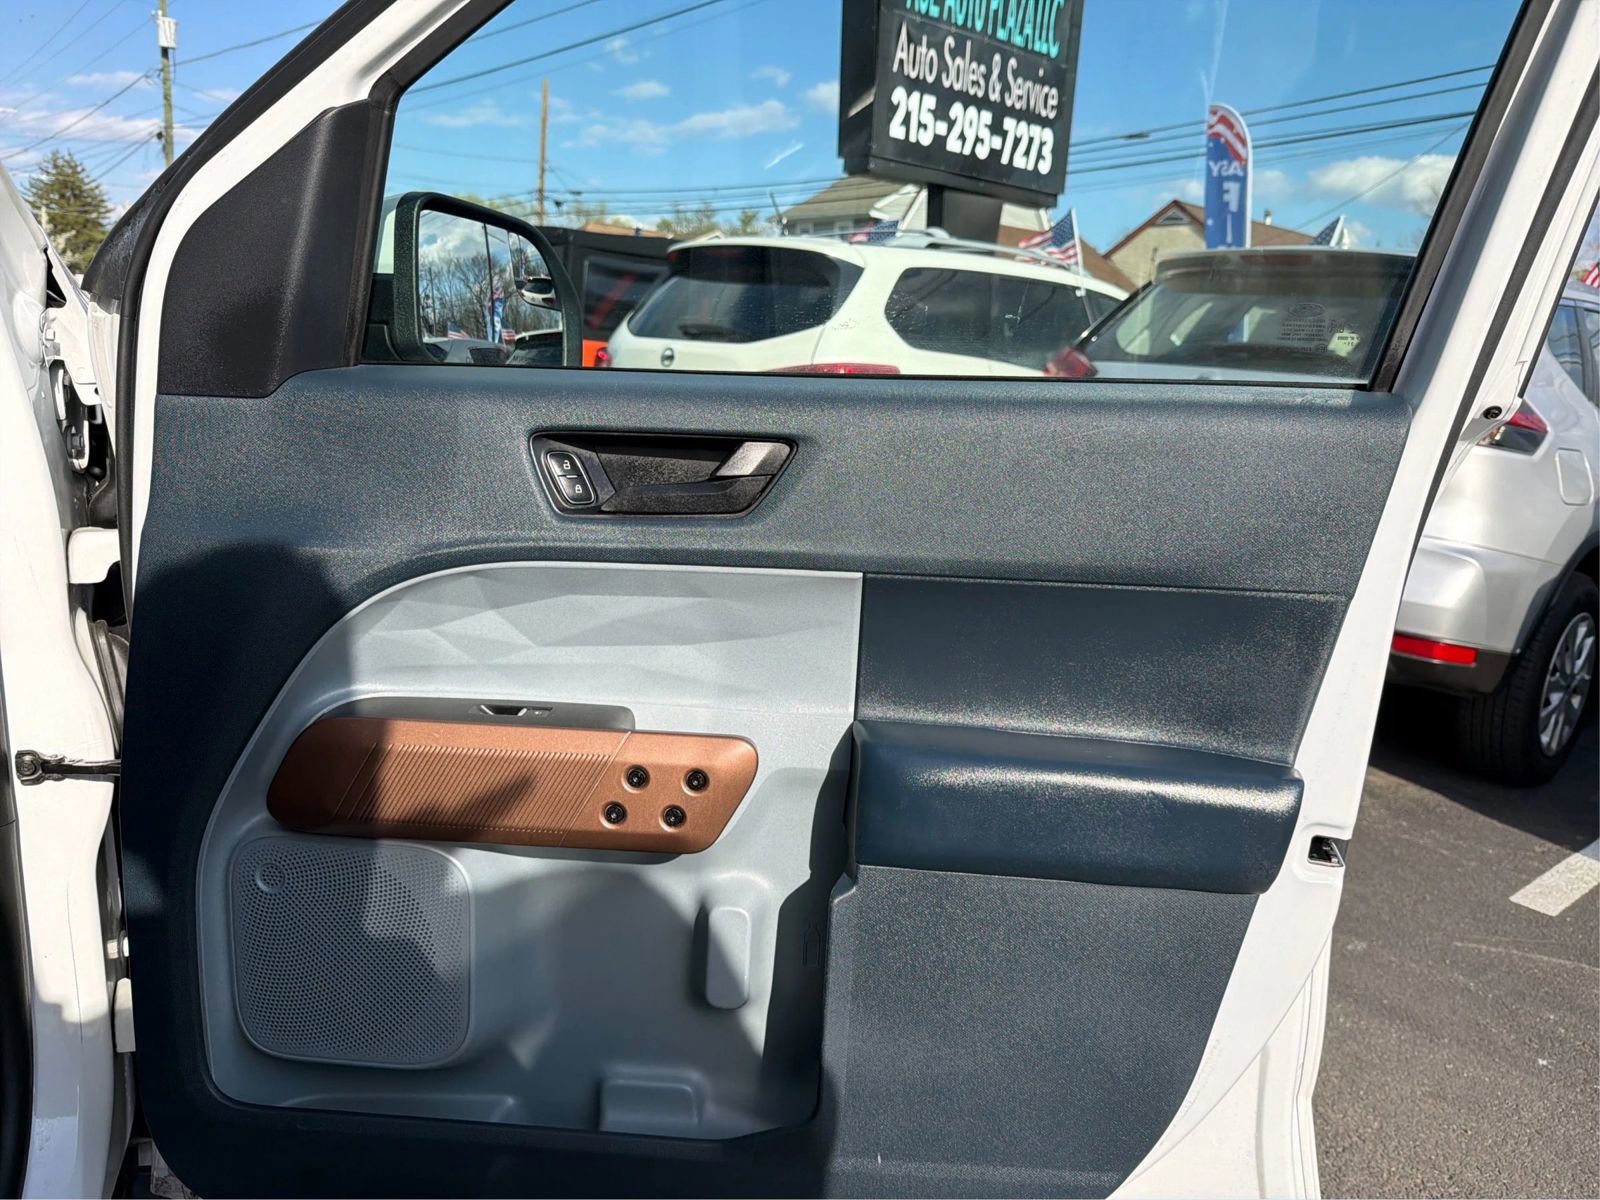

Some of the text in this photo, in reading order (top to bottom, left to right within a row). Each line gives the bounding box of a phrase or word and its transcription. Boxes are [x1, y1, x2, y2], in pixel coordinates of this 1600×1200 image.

[893, 20, 1059, 119] Auto Sales & Service
[889, 86, 1054, 175] 215-295-7273
